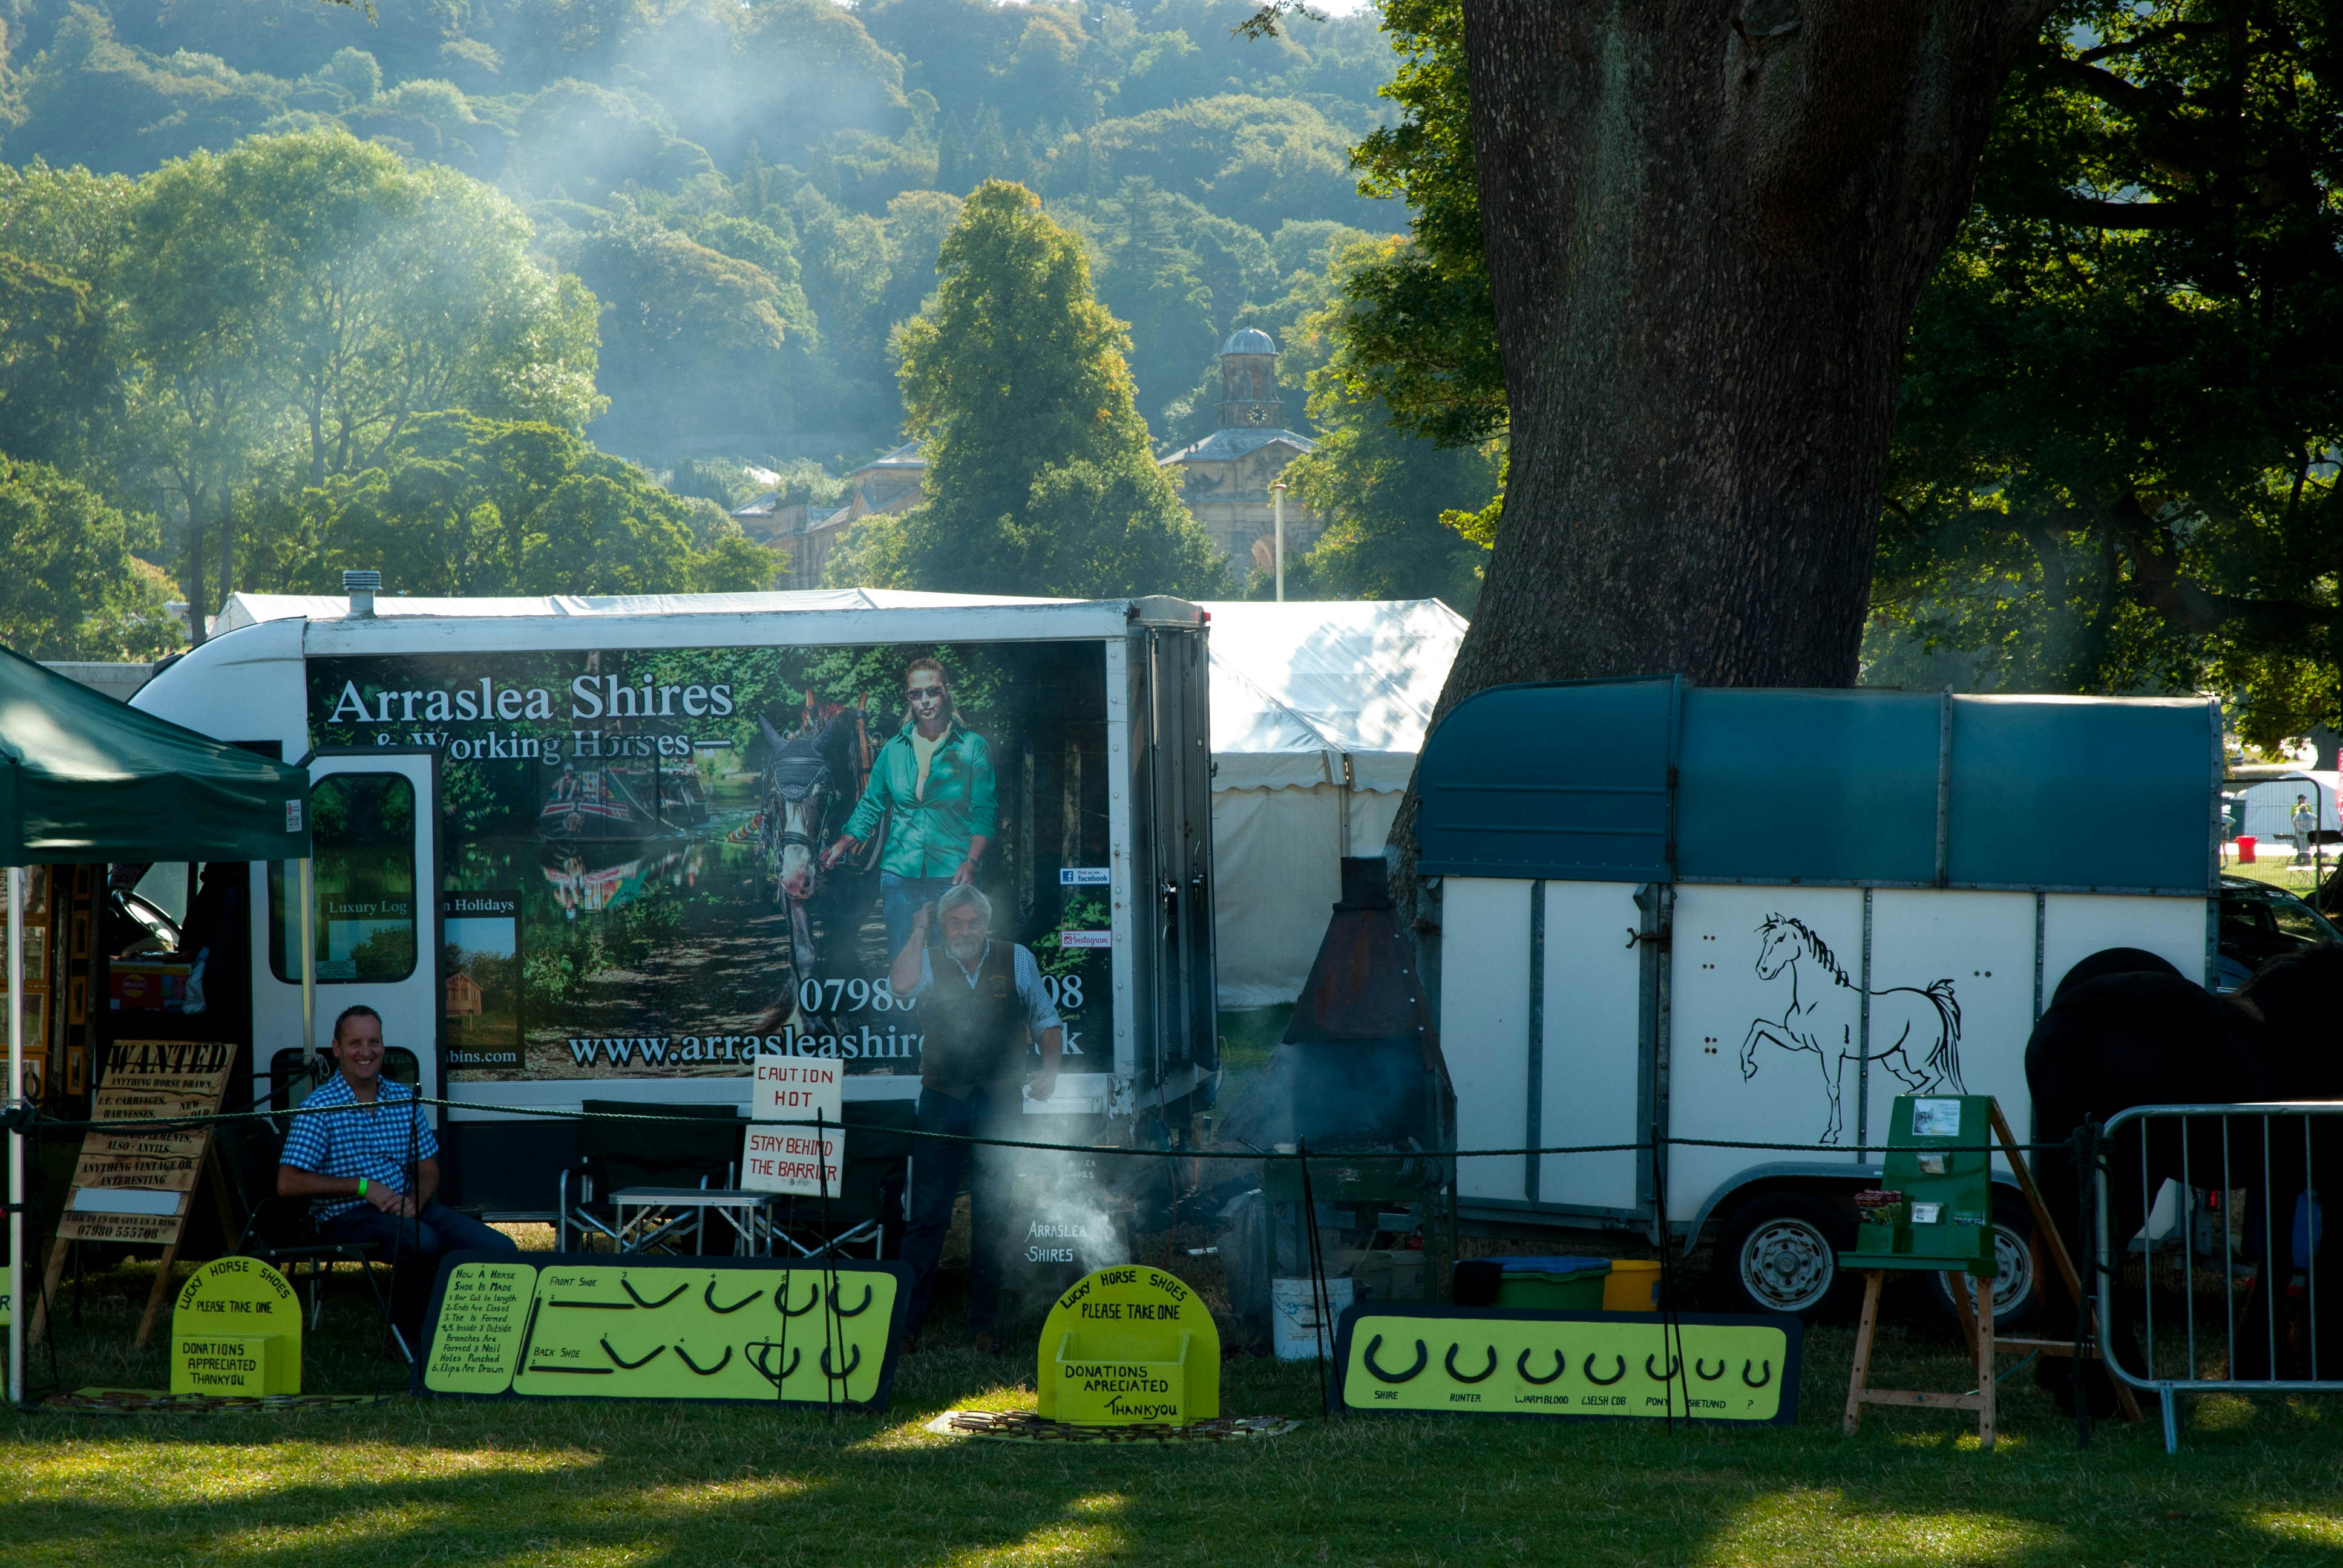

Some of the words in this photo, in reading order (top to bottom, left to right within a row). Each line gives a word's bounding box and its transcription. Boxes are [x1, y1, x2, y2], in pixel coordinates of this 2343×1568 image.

[328, 678, 553, 723] Arraslea
[571, 673, 733, 719] Shires
[572, 730, 689, 758] Horses
[329, 901, 376, 914] Luxury
[381, 901, 407, 914] Log
[455, 899, 514, 912] Holidays
[1073, 936, 1108, 946] Instagram
[110, 1044, 228, 1074] WANTED
[758, 1067, 833, 1083] CAUTION
[111, 1078, 151, 1086] ANYTHING
[116, 1096, 166, 1106] CARRIAGES,
[775, 1091, 813, 1107] HOT
[179, 1100, 200, 1111] NEW
[106, 1141, 129, 1150] ALSO
[750, 1135, 784, 1152] STAY
[82, 1163, 131, 1172] ANYTHING
[135, 1161, 175, 1171] VINTAGE
[178, 1160, 192, 1169] OR
[750, 1158, 775, 1175] THE
[100, 1175, 168, 1186] INTERESTING
[158, 1218, 177, 1227] RING
[77, 1225, 113, 1236] 07980
[116, 1226, 159, 1239] 555708
[1024, 1220, 1088, 1242] ARRASLEA
[1024, 1246, 1073, 1262] SHIRES
[456, 1269, 473, 1278] HOW
[479, 1270, 485, 1278] A
[491, 1269, 516, 1279] HORSE
[180, 1275, 203, 1310] LUCKY
[209, 1261, 249, 1277] HORSE
[259, 1267, 290, 1299] SHOES
[454, 1282, 474, 1290] SHOE
[490, 1282, 512, 1292] MADE
[549, 1276, 575, 1286] FRONT
[578, 1277, 598, 1287] SHOE
[1060, 1281, 1090, 1310] LUCKY
[1100, 1270, 1136, 1287] HORSE
[1149, 1273, 1188, 1302] SHOES
[197, 1301, 225, 1312] PLEASE
[229, 1301, 252, 1313] TAKE
[256, 1301, 273, 1313] ONE
[1083, 1303, 1121, 1319] PLEASE
[1126, 1304, 1155, 1319] TAKE
[1157, 1304, 1181, 1319] ONE
[447, 1333, 480, 1342] Branches
[482, 1334, 497, 1342] Are
[183, 1342, 244, 1355] DONATIONS
[482, 1344, 500, 1353] Nail
[533, 1347, 555, 1357] BACK
[560, 1348, 581, 1358] SHOE
[468, 1353, 500, 1362] Punched
[188, 1358, 256, 1371] APPRECIATED
[462, 1364, 475, 1373] Are
[478, 1364, 503, 1373] Drawn
[1065, 1365, 1147, 1377] DONATIONS
[189, 1372, 244, 1385] THANKYOU
[1084, 1380, 1168, 1393] APRECIATED
[1374, 1390, 1399, 1400] SHIRE
[1449, 1393, 1481, 1403] HUNTER
[1581, 1396, 1608, 1405] WELSH
[1611, 1396, 1627, 1406] COB
[1645, 1397, 1669, 1406] PONY
[1688, 1399, 1726, 1408] SHETLAND
[1747, 1400, 1754, 1410] ?
